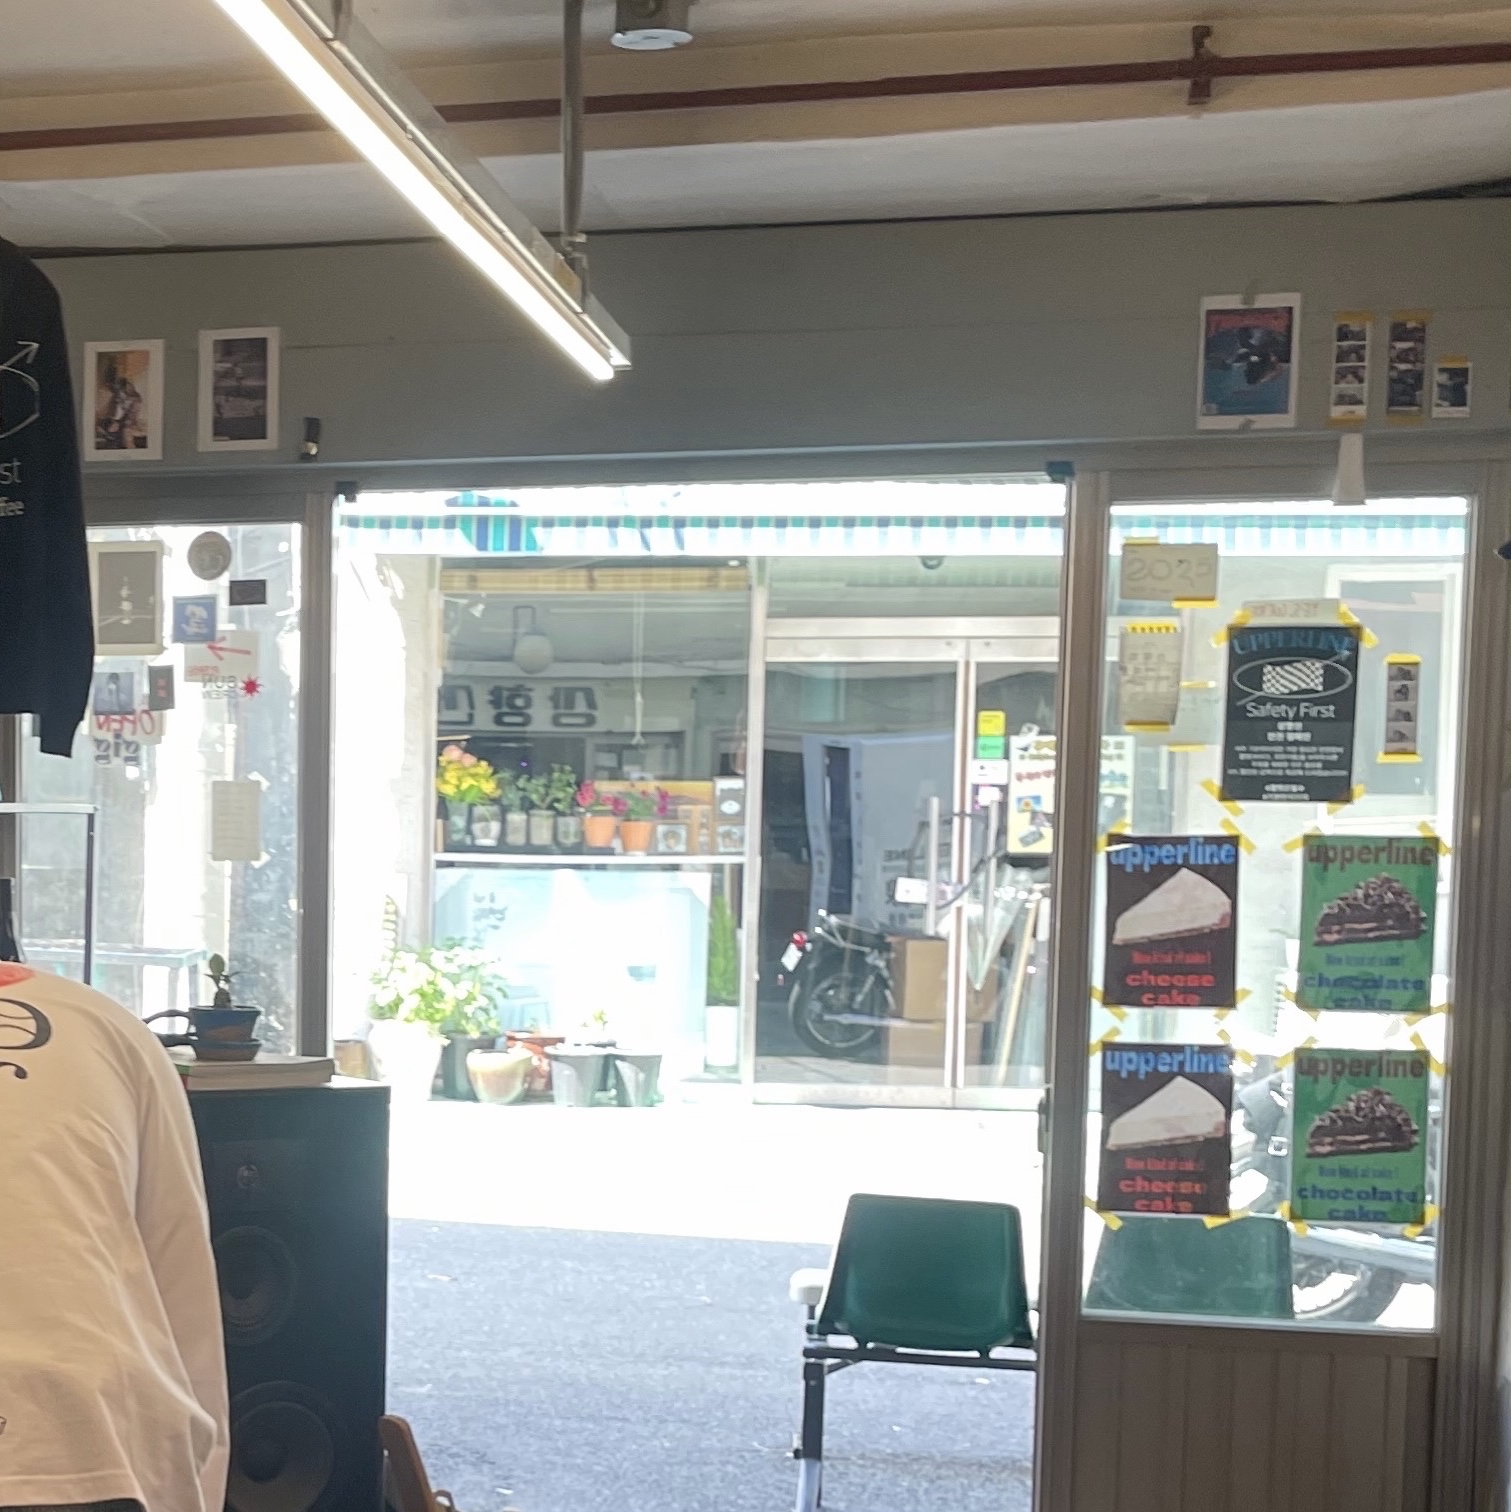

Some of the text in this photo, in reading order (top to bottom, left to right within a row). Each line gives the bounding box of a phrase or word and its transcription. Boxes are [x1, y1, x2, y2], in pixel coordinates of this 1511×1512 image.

[1246, 702, 1336, 720] Safety First
[1109, 836, 1237, 873] upperline
[1306, 838, 1435, 872] upperline
[1125, 970, 1216, 987] cheese
[1303, 973, 1426, 990] chocolate
[1140, 988, 1202, 1006] cake
[1103, 1047, 1229, 1078] upperline
[1296, 1052, 1426, 1079] upperline
[1297, 1185, 1418, 1203] chocolate
